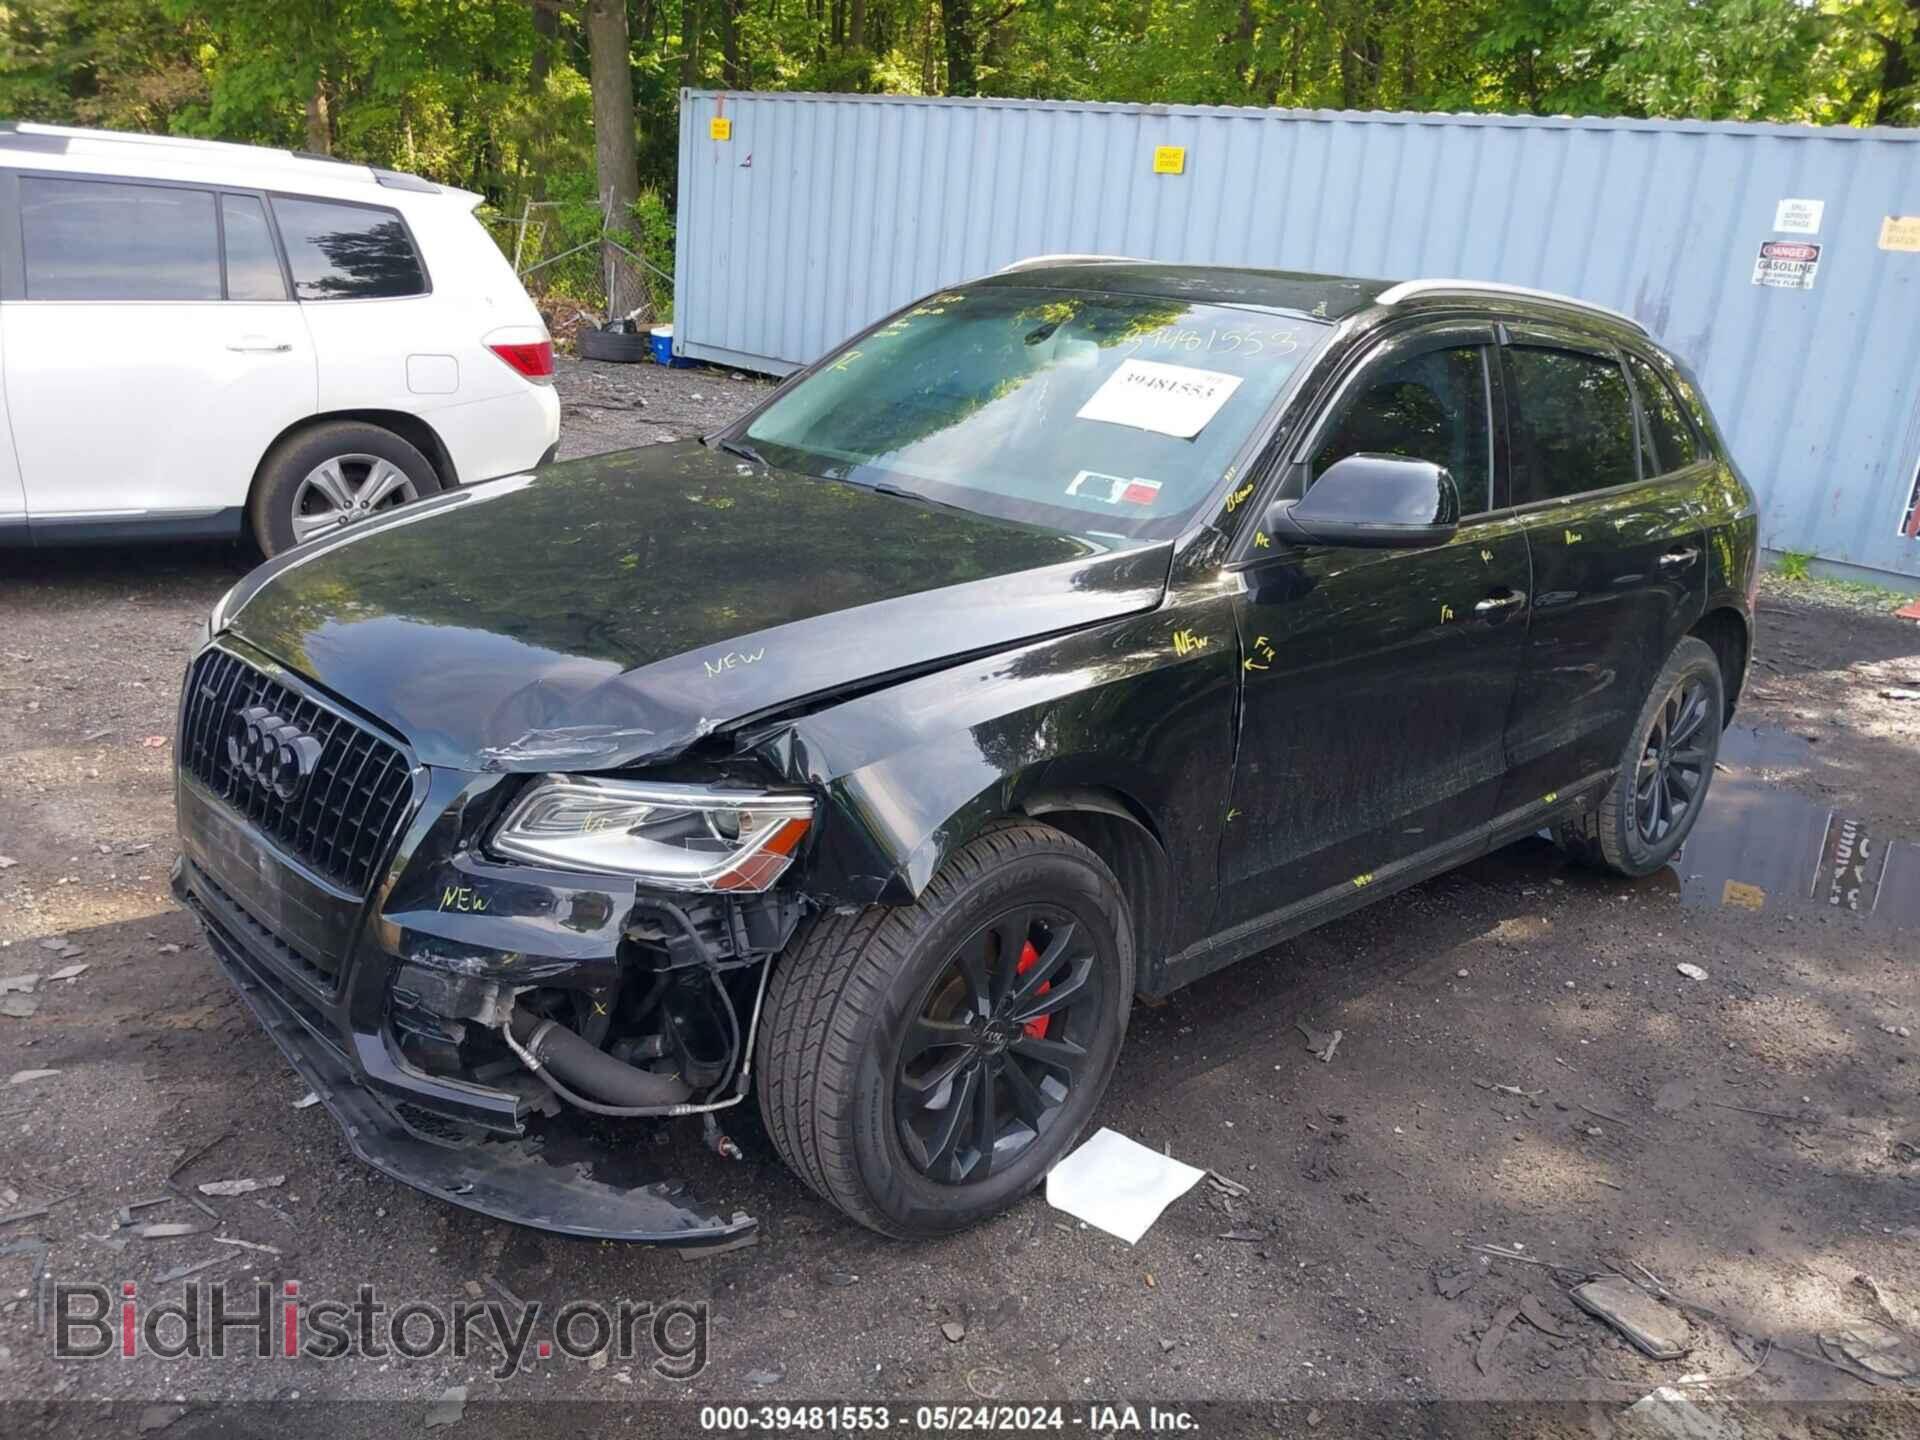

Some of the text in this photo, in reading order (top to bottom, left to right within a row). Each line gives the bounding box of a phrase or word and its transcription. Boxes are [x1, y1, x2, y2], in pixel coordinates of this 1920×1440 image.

[1758, 260, 1816, 274] GASOLINE
[1127, 372, 1215, 398] 39481553
[704, 648, 765, 678] NEW
